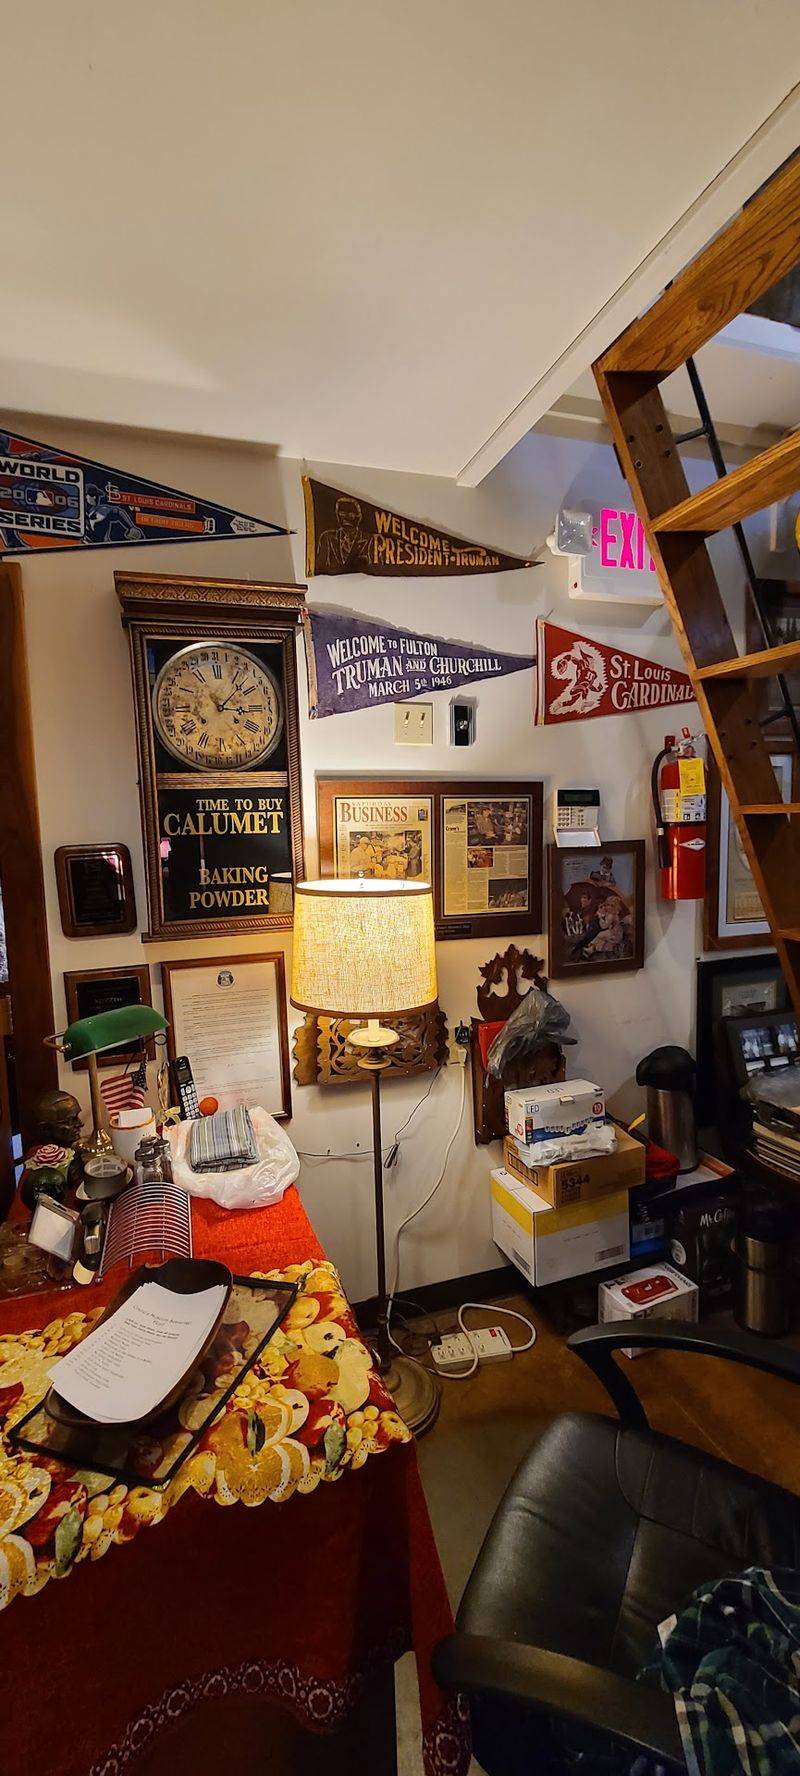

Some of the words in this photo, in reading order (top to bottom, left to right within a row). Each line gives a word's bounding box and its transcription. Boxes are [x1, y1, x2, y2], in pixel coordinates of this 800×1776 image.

[0, 461, 80, 483] WORLD
[132, 495, 154, 506] LOUIS
[155, 499, 192, 511] CARDINALS
[0, 511, 81, 533] SERIES
[374, 511, 450, 551] WELCOME
[373, 533, 449, 566] PRESIDENT
[455, 552, 501, 566] TRUMAN
[600, 508, 656, 572] EXI
[326, 635, 387, 669] WELCOME
[400, 638, 438, 656] FULTON
[331, 655, 404, 696] TRUMAN
[405, 657, 427, 673] AND
[429, 656, 502, 676] CHURCHILL
[609, 654, 631, 680] St.
[634, 661, 671, 682] Louis
[368, 679, 410, 699] MARCH
[430, 676, 453, 688] 1946
[611, 680, 697, 711] CARDINAL
[196, 798, 230, 811] TIME
[235, 798, 253, 811] TO
[258, 798, 283, 811] BUY
[340, 802, 408, 822] BUSINESS
[163, 811, 284, 836] CALUMET
[199, 866, 269, 886] BAKING
[189, 889, 270, 909] POWDER
[526, 1104, 540, 1114] LED
